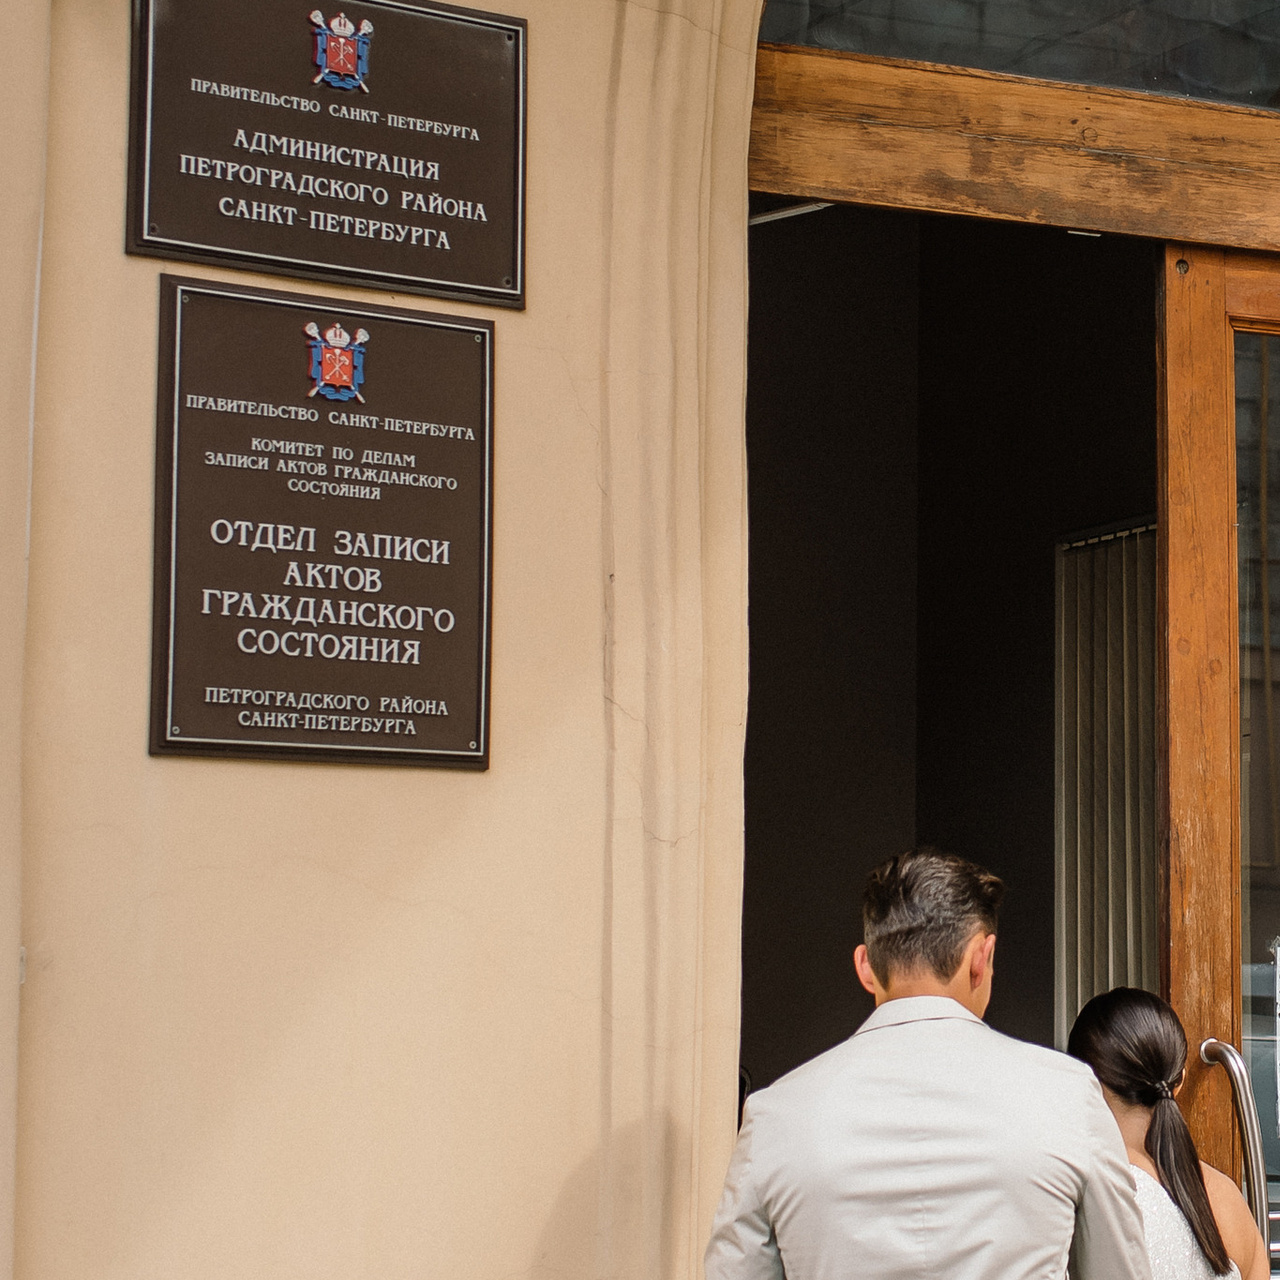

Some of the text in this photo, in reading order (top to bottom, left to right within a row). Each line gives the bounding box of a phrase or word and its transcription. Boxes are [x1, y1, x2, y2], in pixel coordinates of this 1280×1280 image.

[191, 78, 480, 141] ПРАВИТЕЛЬСТВО САНКТ-ПЕТЕРБУРГА
[233, 128, 439, 181] АДМИНИСТРАЦИЯ
[180, 154, 487, 221] ПЕТРОГРАДСКОГО РАЙОНА
[218, 197, 450, 250] САНКТ-ПЕТЕРБУРГА
[186, 394, 475, 441] ПРАВИТЕЛЬСТВО САНКТ-ПЕТЕРБУРГА
[205, 452, 457, 490] ЗАПИСИ АКТОВ ГРАЖДАНСКОГО
[251, 438, 416, 467] КОМИТЕТ ПО ДЕЛАМ
[288, 478, 381, 500] СОСТОЯНИЯ
[210, 519, 450, 564] ОТДЕЛ ЗАПИСИ
[283, 562, 382, 593] АКТОВ
[201, 589, 455, 633] ГРАЖДАНСКОГО
[237, 628, 420, 664] СОСТОЯНИЯ
[205, 687, 448, 715] ПЕТРОГРАДСКОГО РАЙОНА
[238, 711, 416, 735] САНКТ-ПЕТЕРБУРГА
